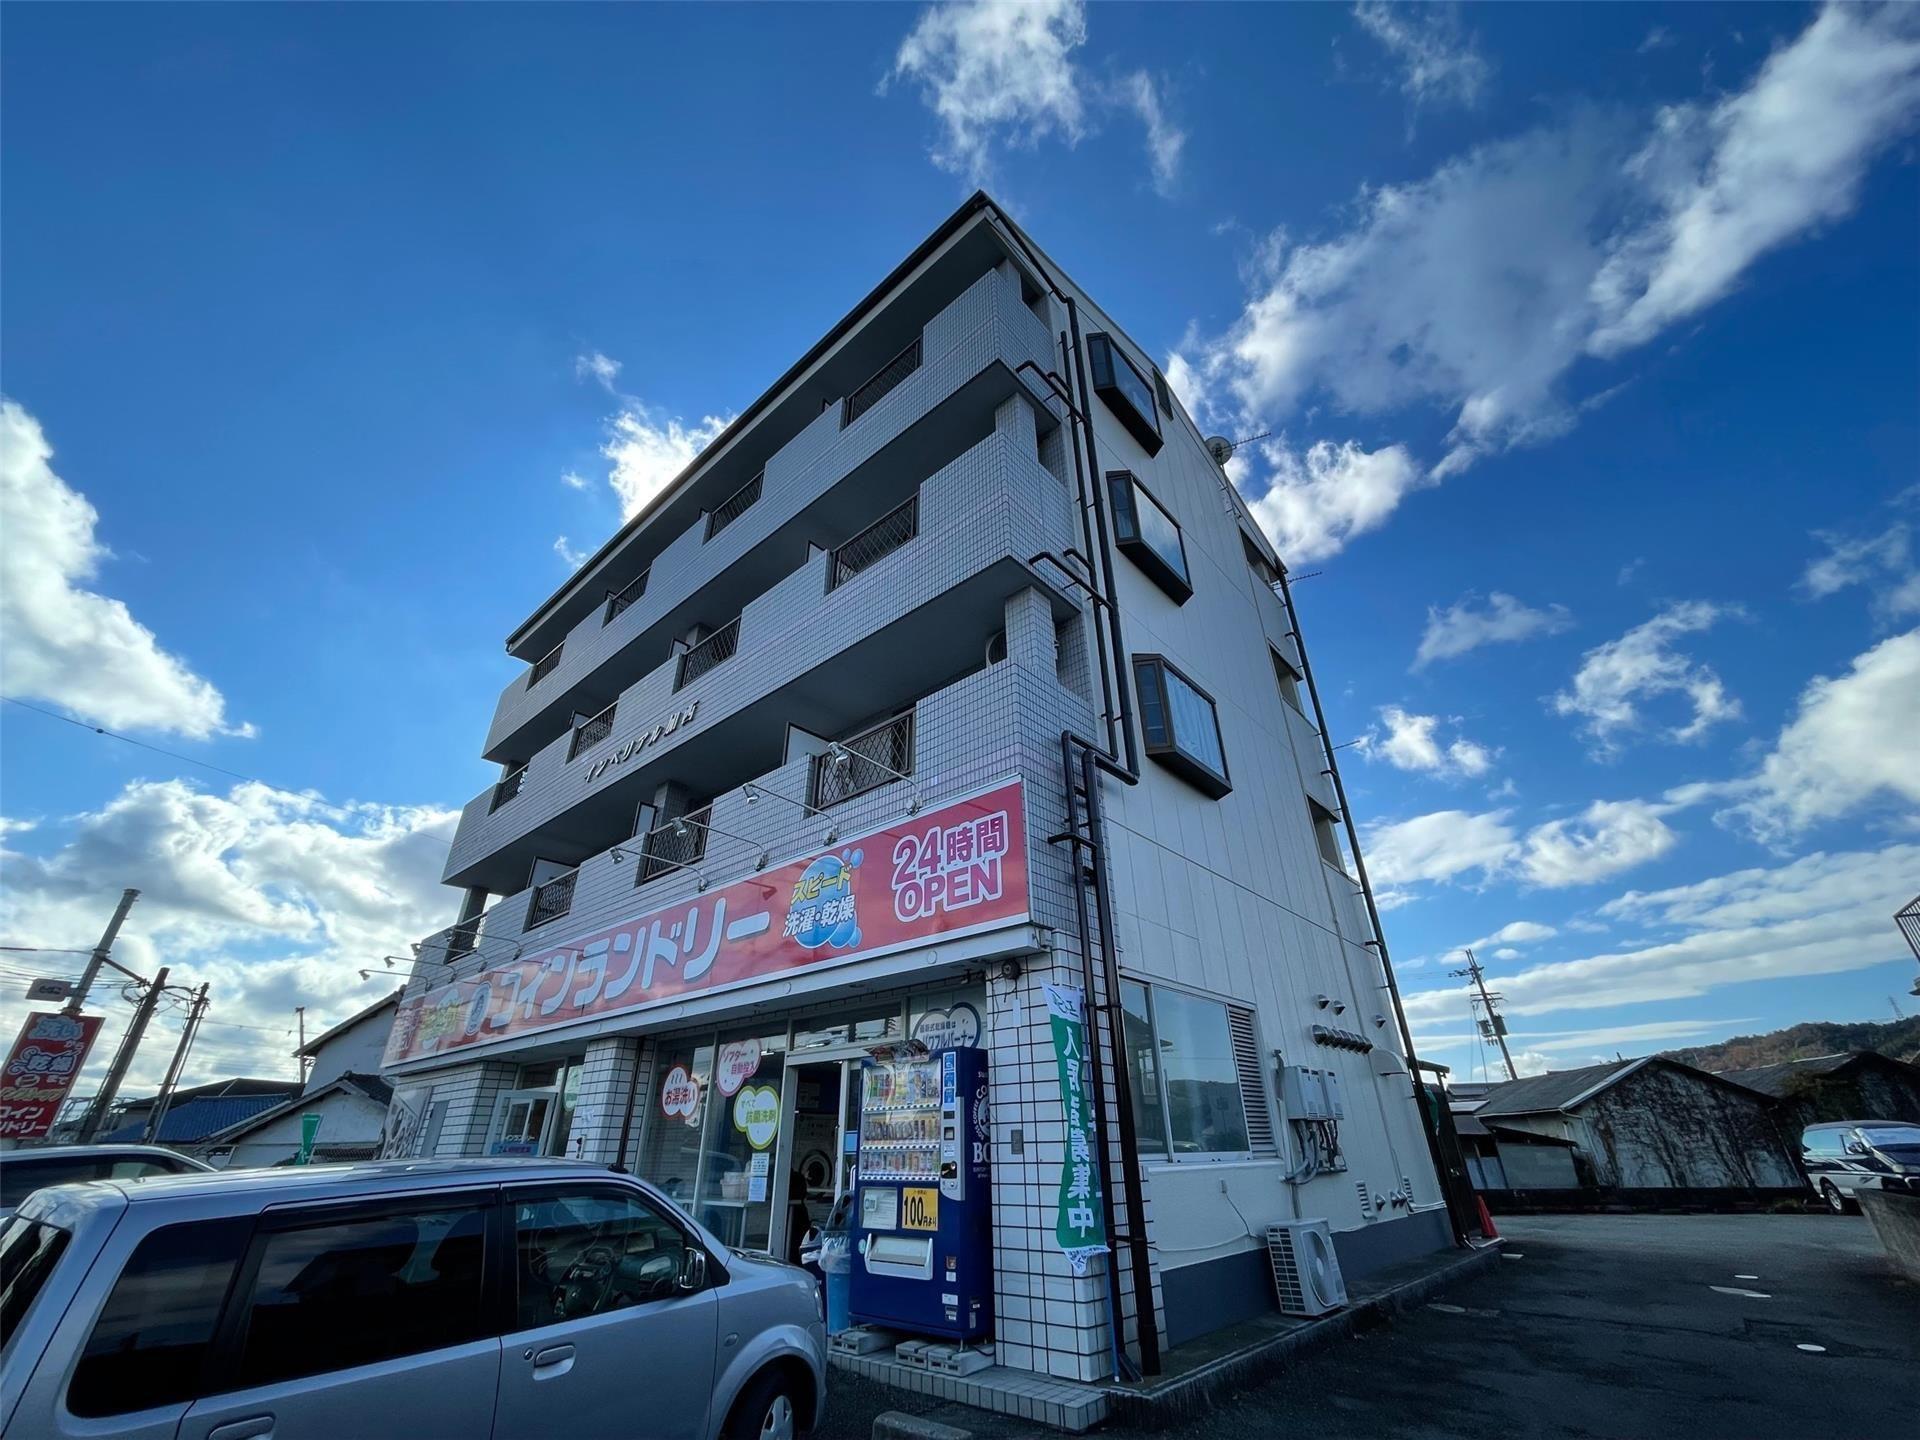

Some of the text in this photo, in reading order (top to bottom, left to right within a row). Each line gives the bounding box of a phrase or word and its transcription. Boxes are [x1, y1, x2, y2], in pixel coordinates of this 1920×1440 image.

[894, 814, 1006, 886] 24時間
[790, 863, 853, 904] スピード
[896, 858, 1001, 920] OPEN
[783, 894, 856, 938] 洗濯・乾燥
[490, 897, 771, 1028] コインランドリー
